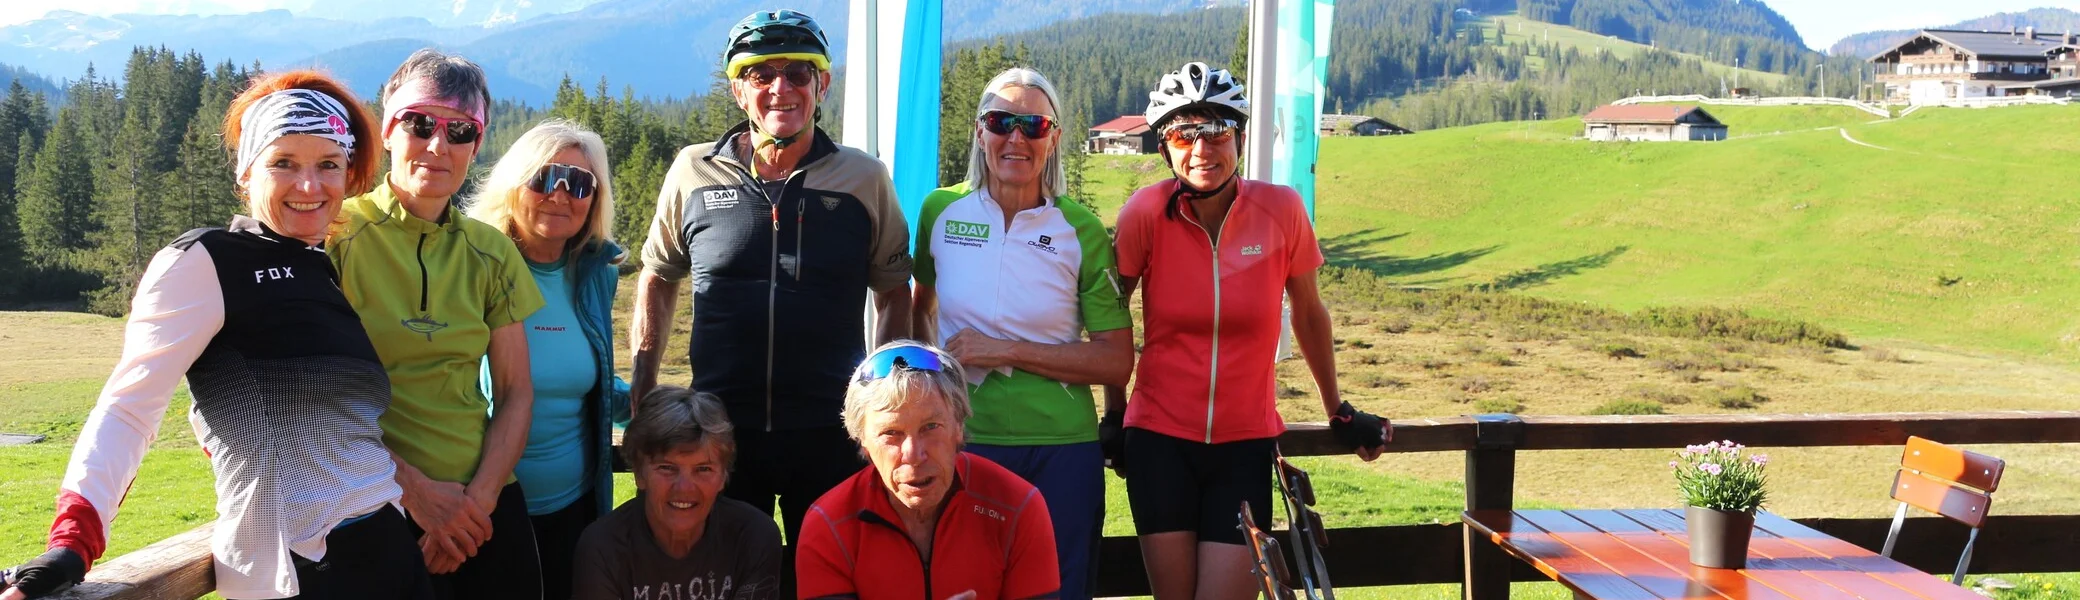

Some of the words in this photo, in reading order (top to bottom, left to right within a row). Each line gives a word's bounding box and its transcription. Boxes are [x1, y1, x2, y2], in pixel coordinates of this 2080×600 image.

[714, 191, 735, 200] DAV
[958, 223, 988, 237] DAV
[254, 266, 295, 284] FOX
